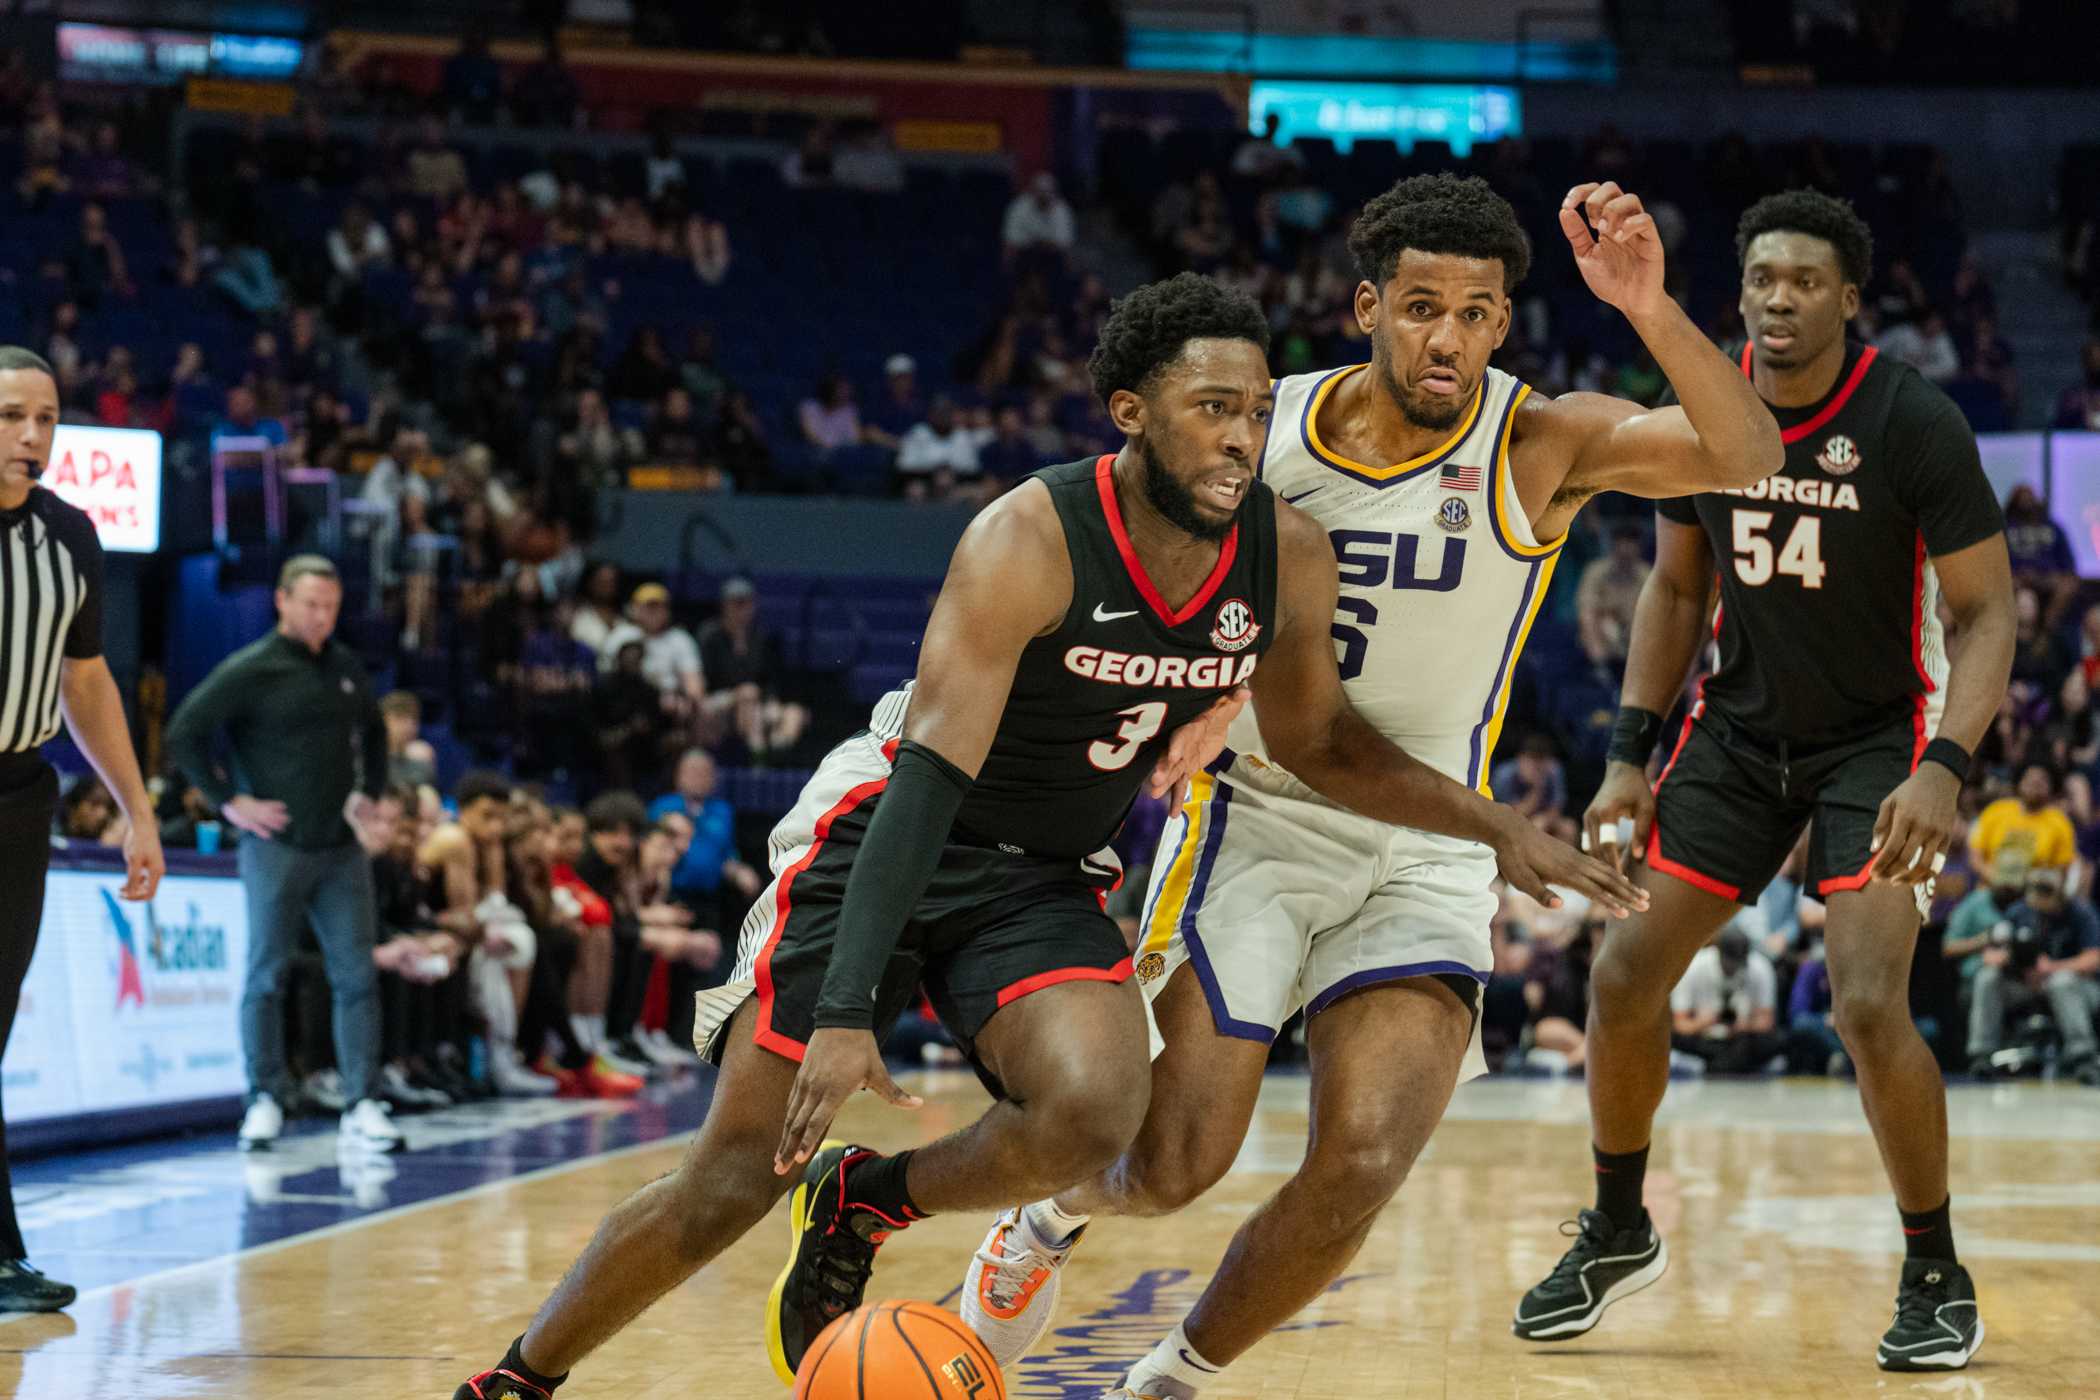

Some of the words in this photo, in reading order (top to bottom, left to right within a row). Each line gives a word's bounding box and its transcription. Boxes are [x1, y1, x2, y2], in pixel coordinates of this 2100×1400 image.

[1826, 435, 1853, 465] SEC
[49, 450, 137, 490] APA
[1443, 499, 1467, 524] SEC
[1711, 475, 1860, 511] ORGIA
[1329, 529, 1467, 592] SU
[1731, 508, 1827, 589] 54
[1218, 601, 1250, 640] SEC
[1213, 633, 1254, 651] GRADUATE
[1064, 645, 1257, 688] GEORGIA
[1088, 701, 1168, 771] 3
